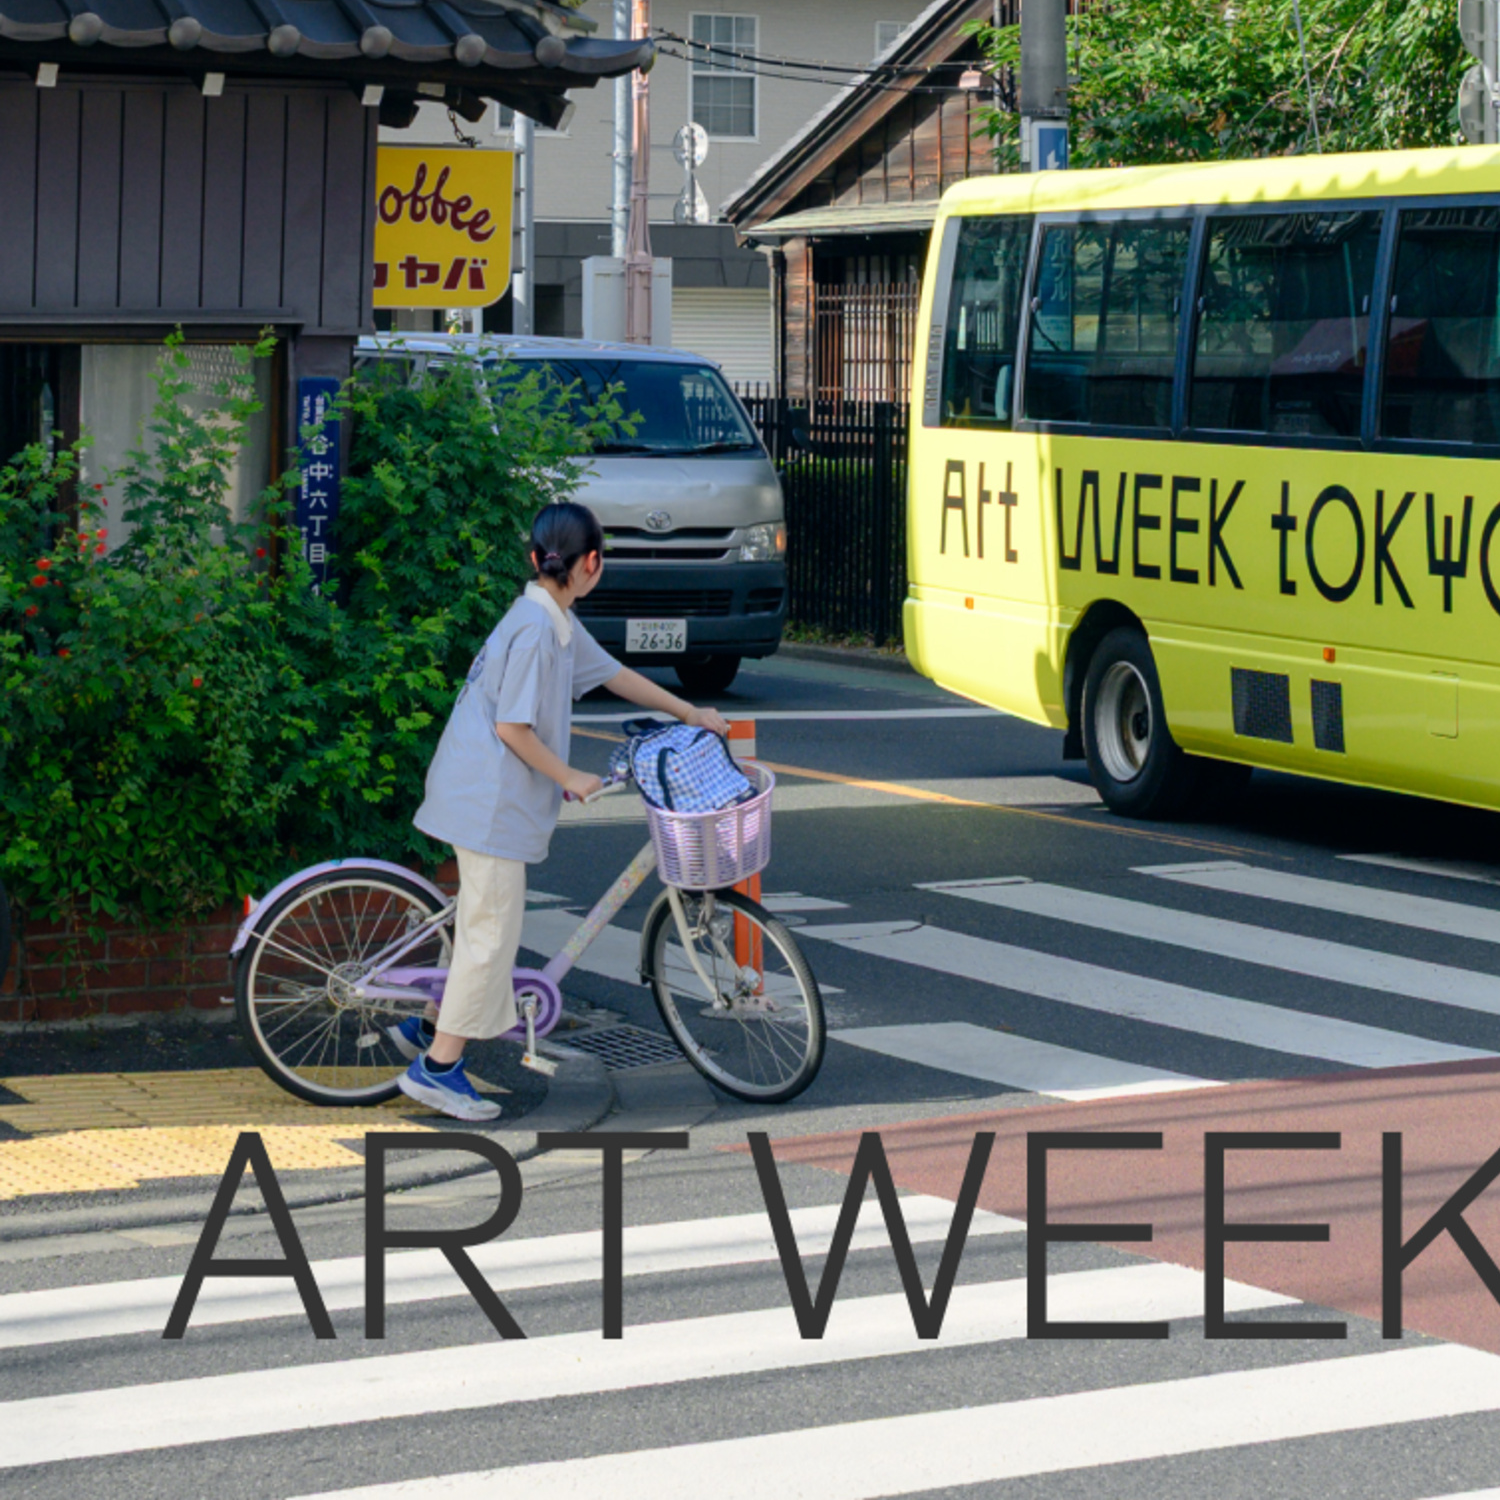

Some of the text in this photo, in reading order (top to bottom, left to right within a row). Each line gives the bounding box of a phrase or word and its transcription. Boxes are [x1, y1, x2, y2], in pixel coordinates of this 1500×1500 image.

[376, 161, 496, 243] offee
[309, 434, 329, 564] 谷中六丁目
[1055, 468, 1246, 591] WEEK
[639, 632, 683, 650] 26-36
